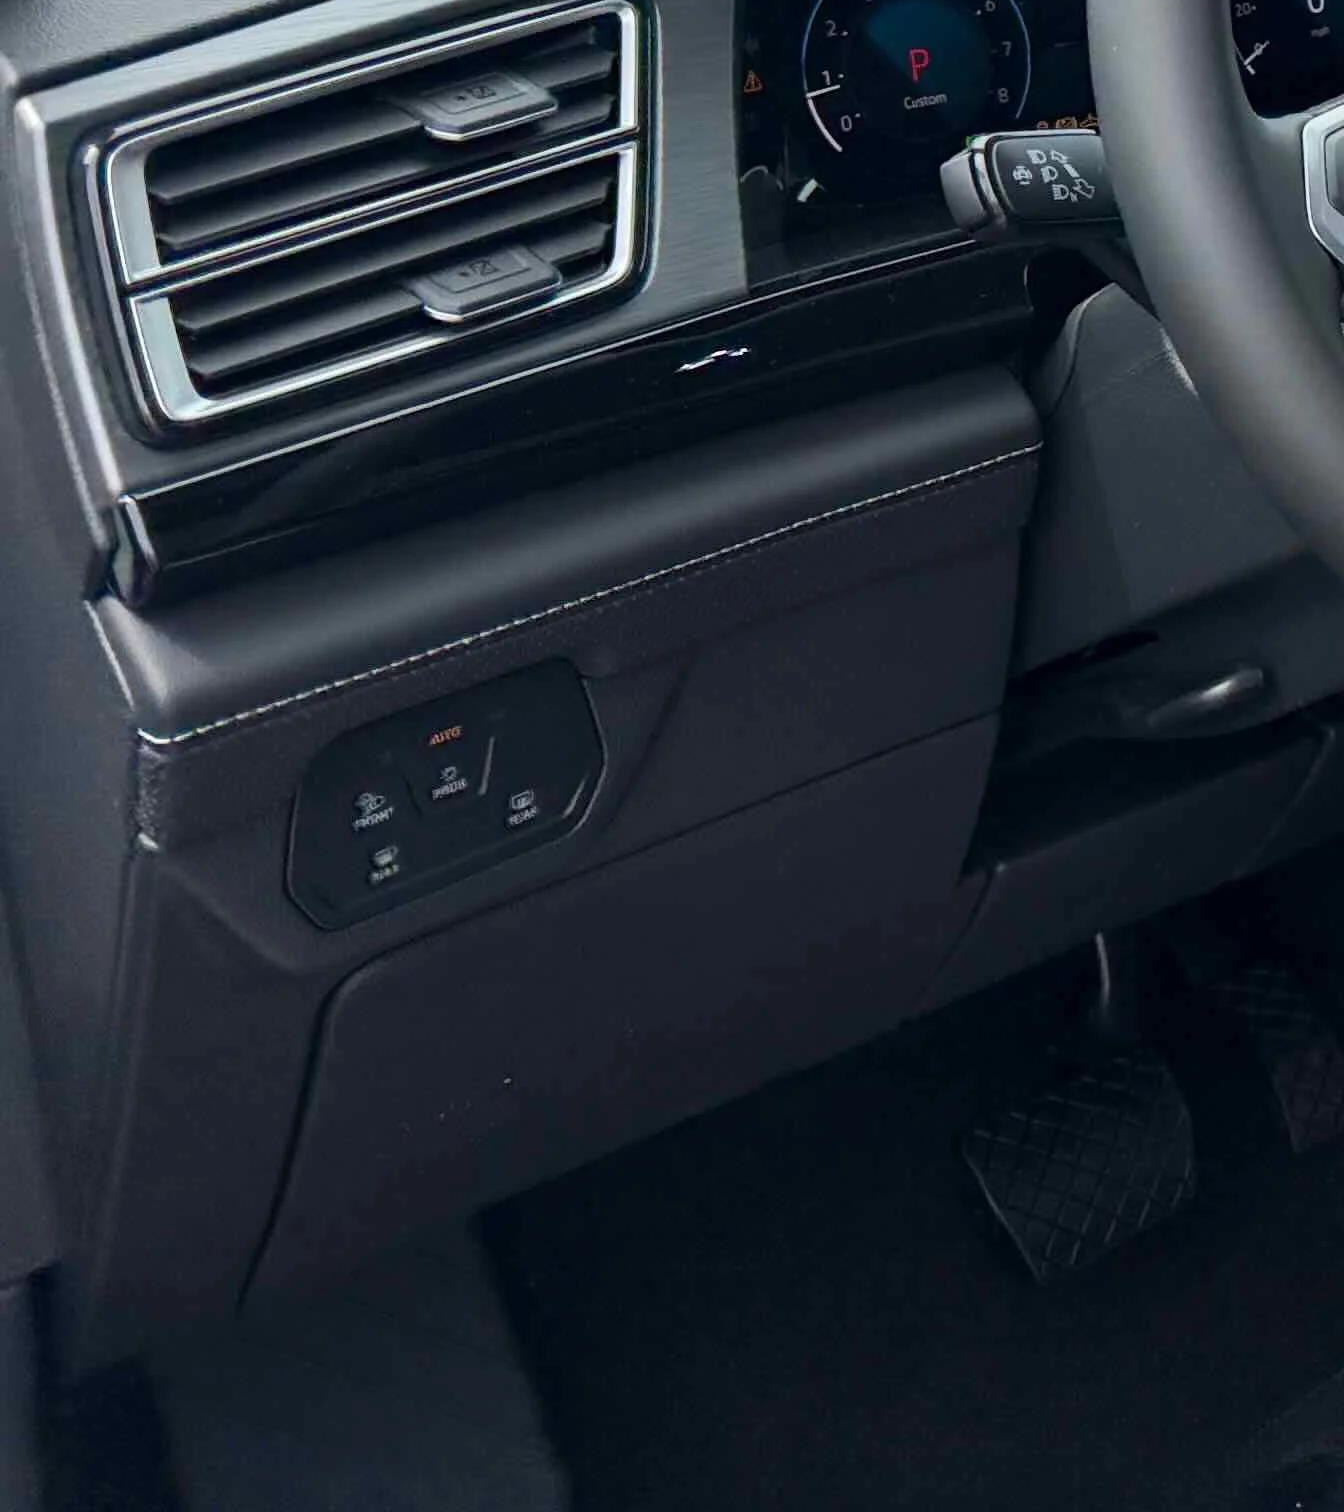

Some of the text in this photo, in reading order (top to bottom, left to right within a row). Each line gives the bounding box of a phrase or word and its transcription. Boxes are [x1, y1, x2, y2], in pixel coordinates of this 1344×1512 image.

[1234, 2, 1251, 17] 20
[825, 20, 837, 36] 2
[1001, 41, 1012, 56] 7
[909, 48, 929, 81] P
[821, 70, 832, 85] 1
[904, 92, 947, 109] Custom
[997, 88, 1009, 103] 8
[840, 115, 852, 132] 0
[428, 725, 464, 746] AUTO
